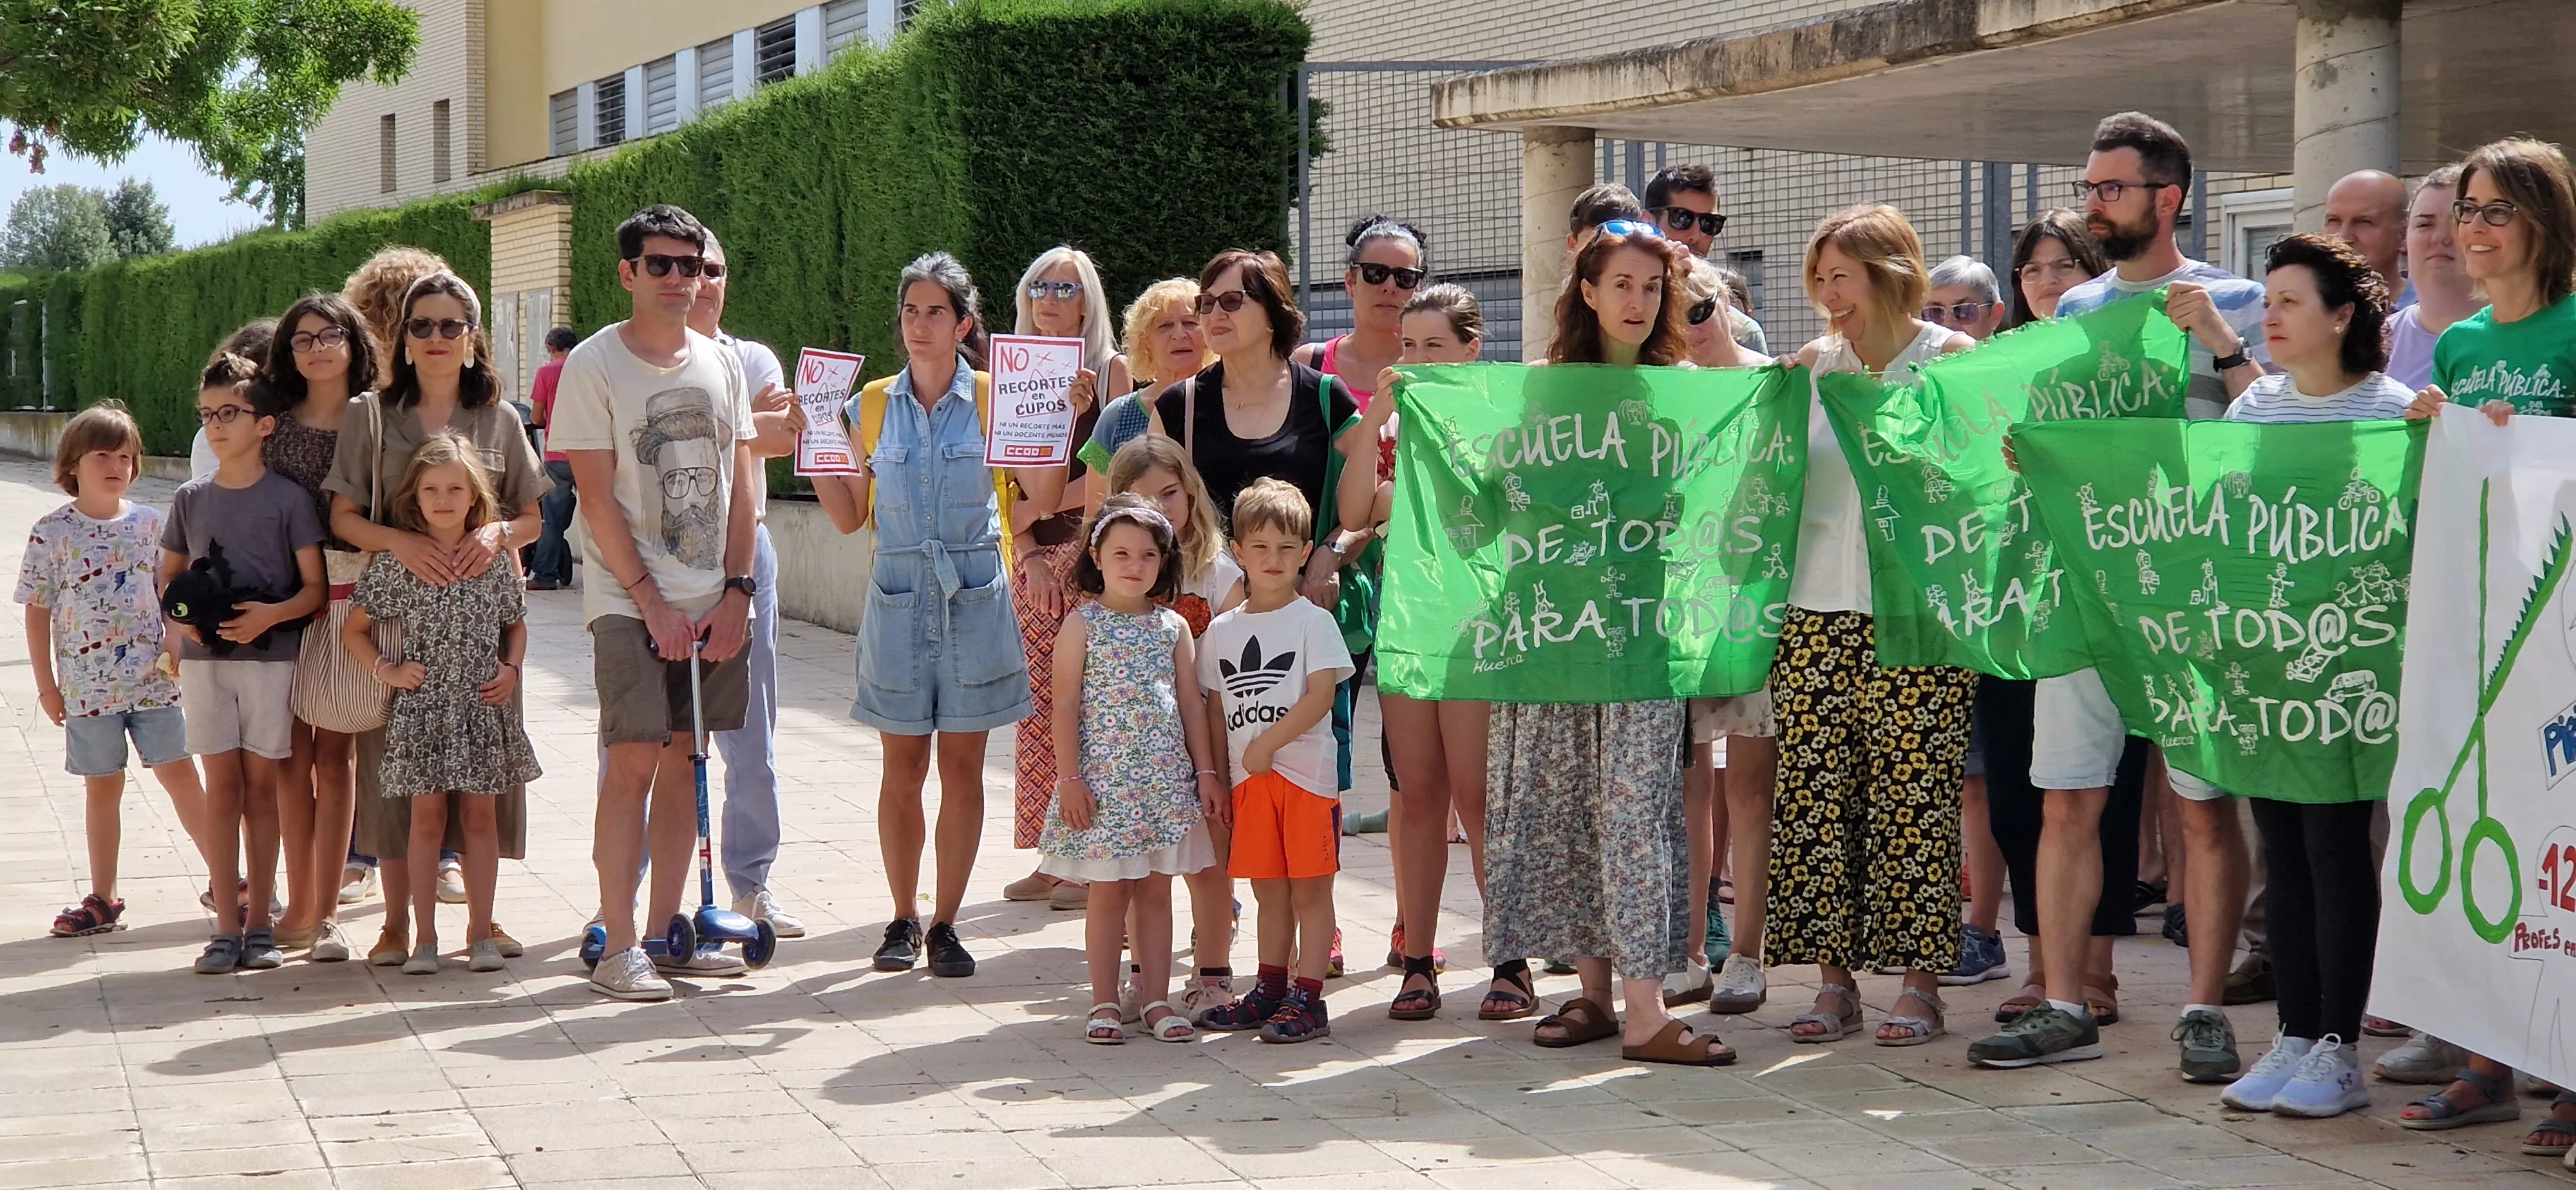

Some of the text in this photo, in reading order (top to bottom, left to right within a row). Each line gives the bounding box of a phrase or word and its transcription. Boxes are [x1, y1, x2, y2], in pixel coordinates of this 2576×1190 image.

[801, 358, 824, 386] NO
[1000, 345, 1030, 373] NO
[998, 375, 1076, 395] RECORTES
[2498, 367, 2567, 398] PÚBLICA:
[1015, 399, 1067, 415] CUPOS
[1006, 446, 1039, 456] CCOO
[1448, 411, 1795, 482] ESCUELA PÚBLICA:
[1920, 509, 1987, 565] DE
[2083, 484, 2230, 550] ESCUELA
[1504, 510, 1764, 571] DE TOD@S
[1470, 596, 1788, 659] PARA TOD@S
[2138, 603, 2397, 656] DE TOD@S
[2248, 692, 2400, 745] TOD@
[2514, 921, 2561, 952] PROFES
